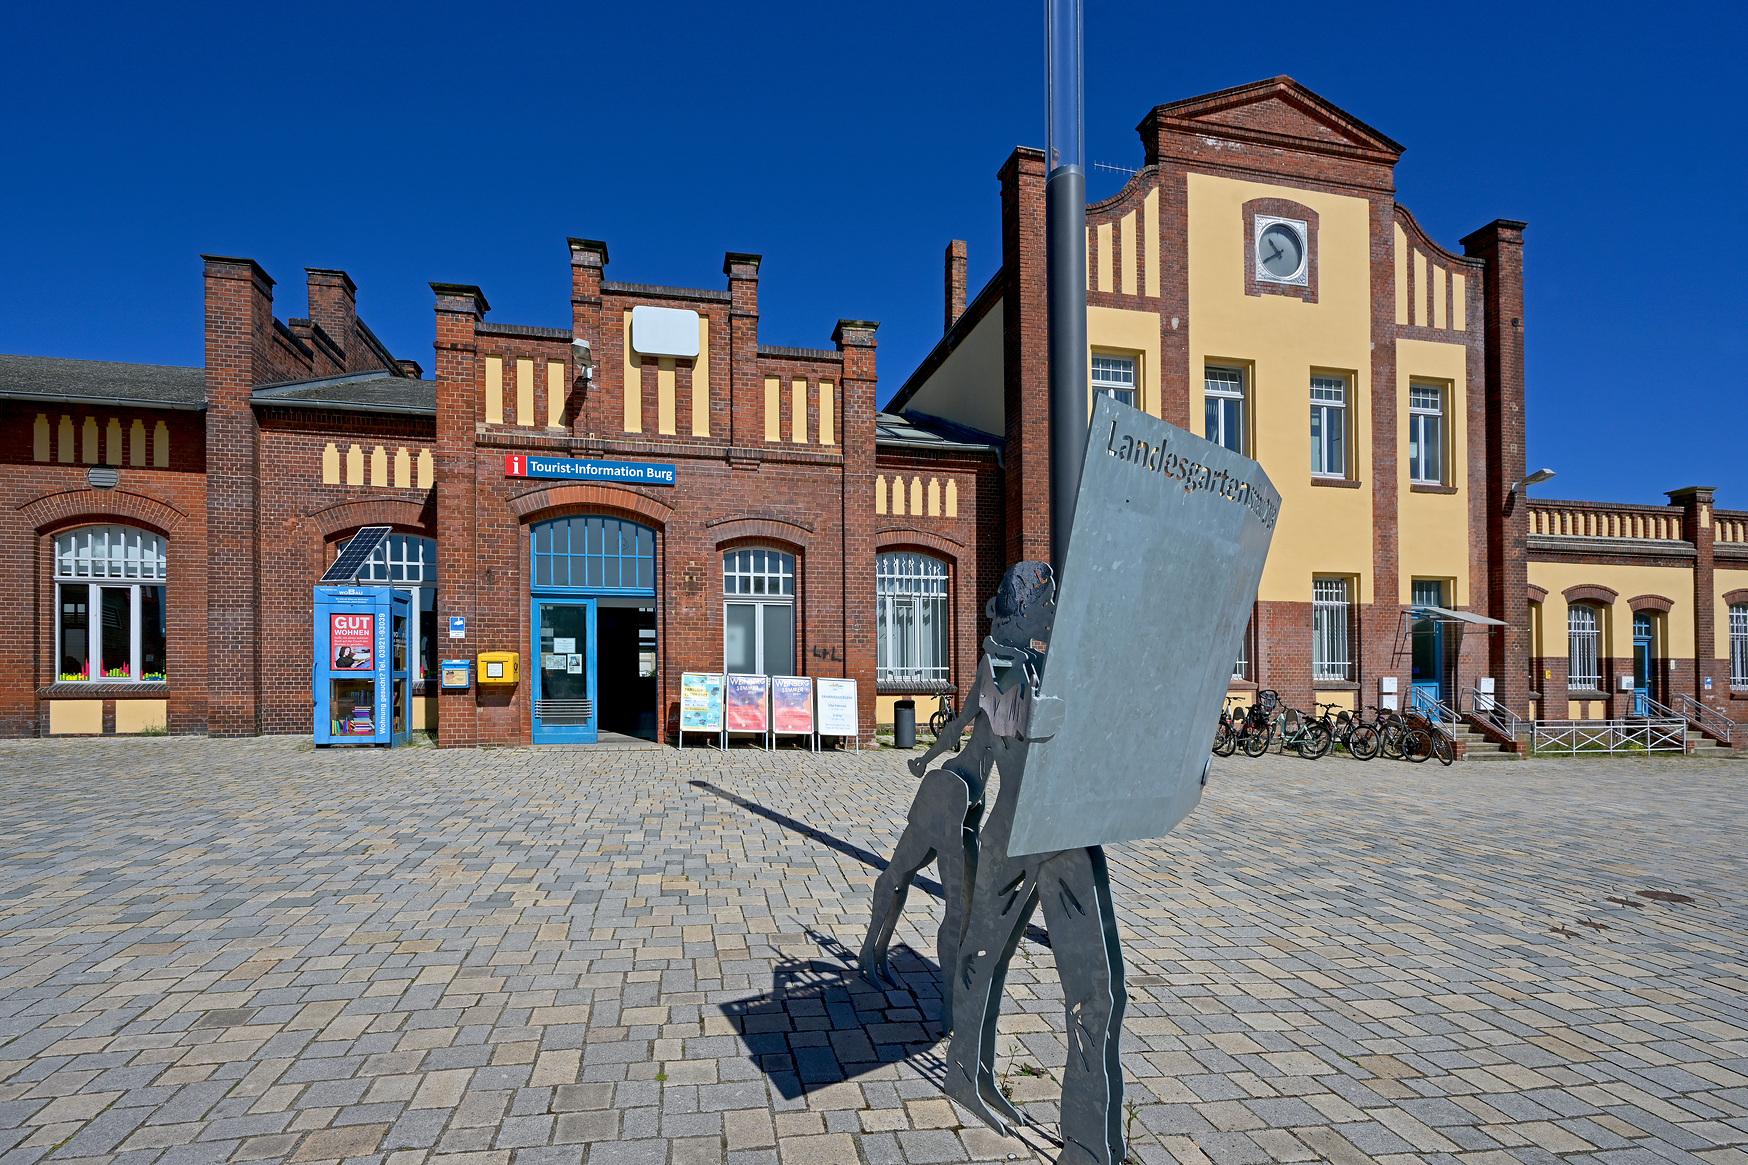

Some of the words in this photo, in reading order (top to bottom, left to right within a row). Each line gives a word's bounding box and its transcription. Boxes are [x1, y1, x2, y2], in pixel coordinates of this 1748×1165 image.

[530, 461, 643, 477] Tourist-Information
[647, 467, 673, 480] Burg
[334, 616, 370, 629] GUT
[379, 673, 387, 702] gesucht?
[379, 702, 387, 735] Wohnung
